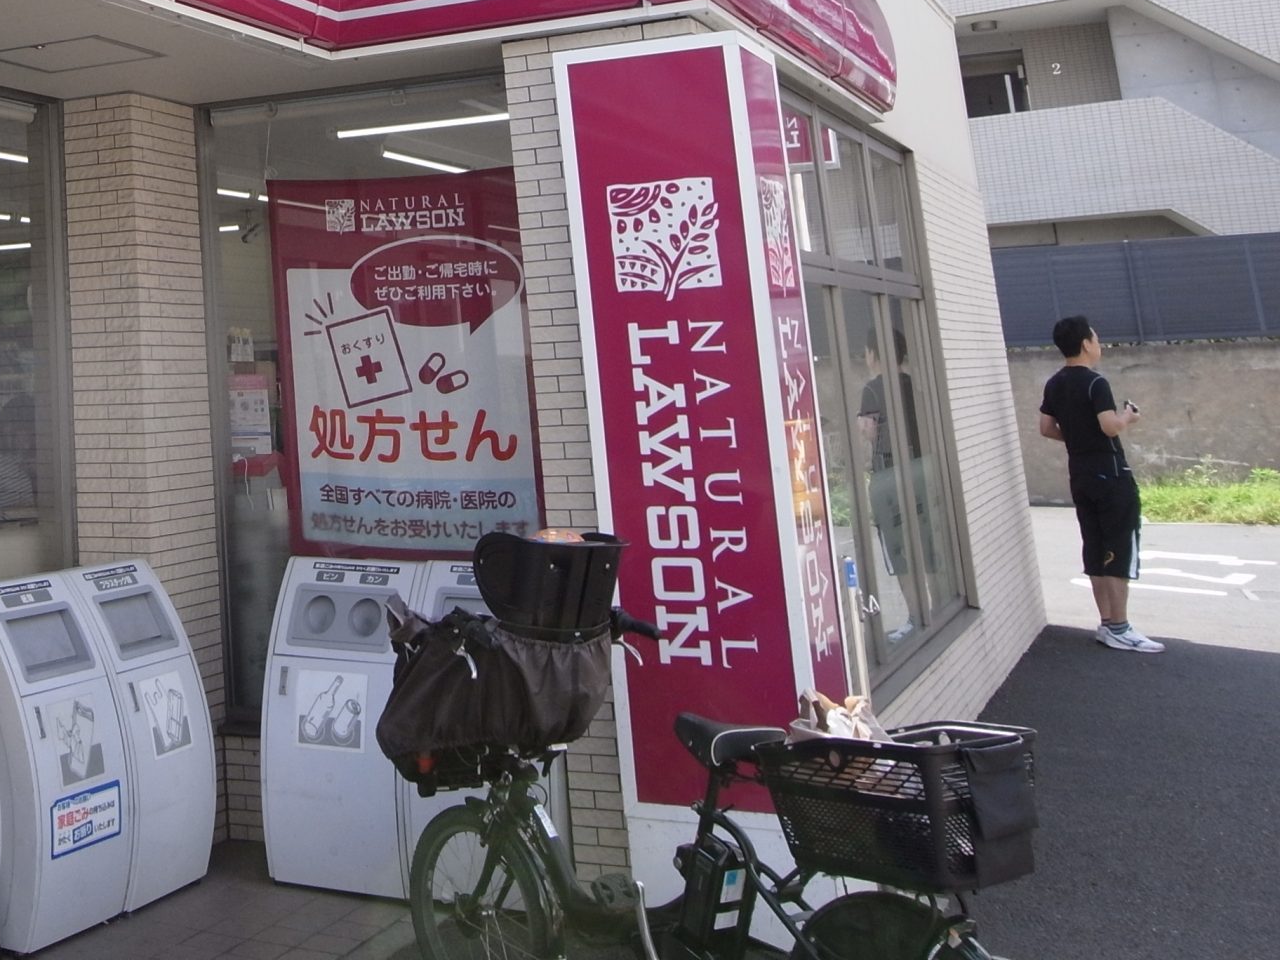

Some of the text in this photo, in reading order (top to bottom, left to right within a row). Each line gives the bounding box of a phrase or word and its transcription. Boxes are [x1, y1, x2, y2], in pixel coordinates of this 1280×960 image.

[1052, 63, 1061, 75] 2
[360, 193, 465, 212] NATURAL
[360, 208, 465, 232] LAWSON
[341, 333, 385, 355] おくすり
[308, 404, 518, 464] 処方せん
[320, 483, 517, 510] 全国すべての病院・医院の
[628, 319, 713, 666] LAWSON
[687, 319, 759, 670] NATURAL
